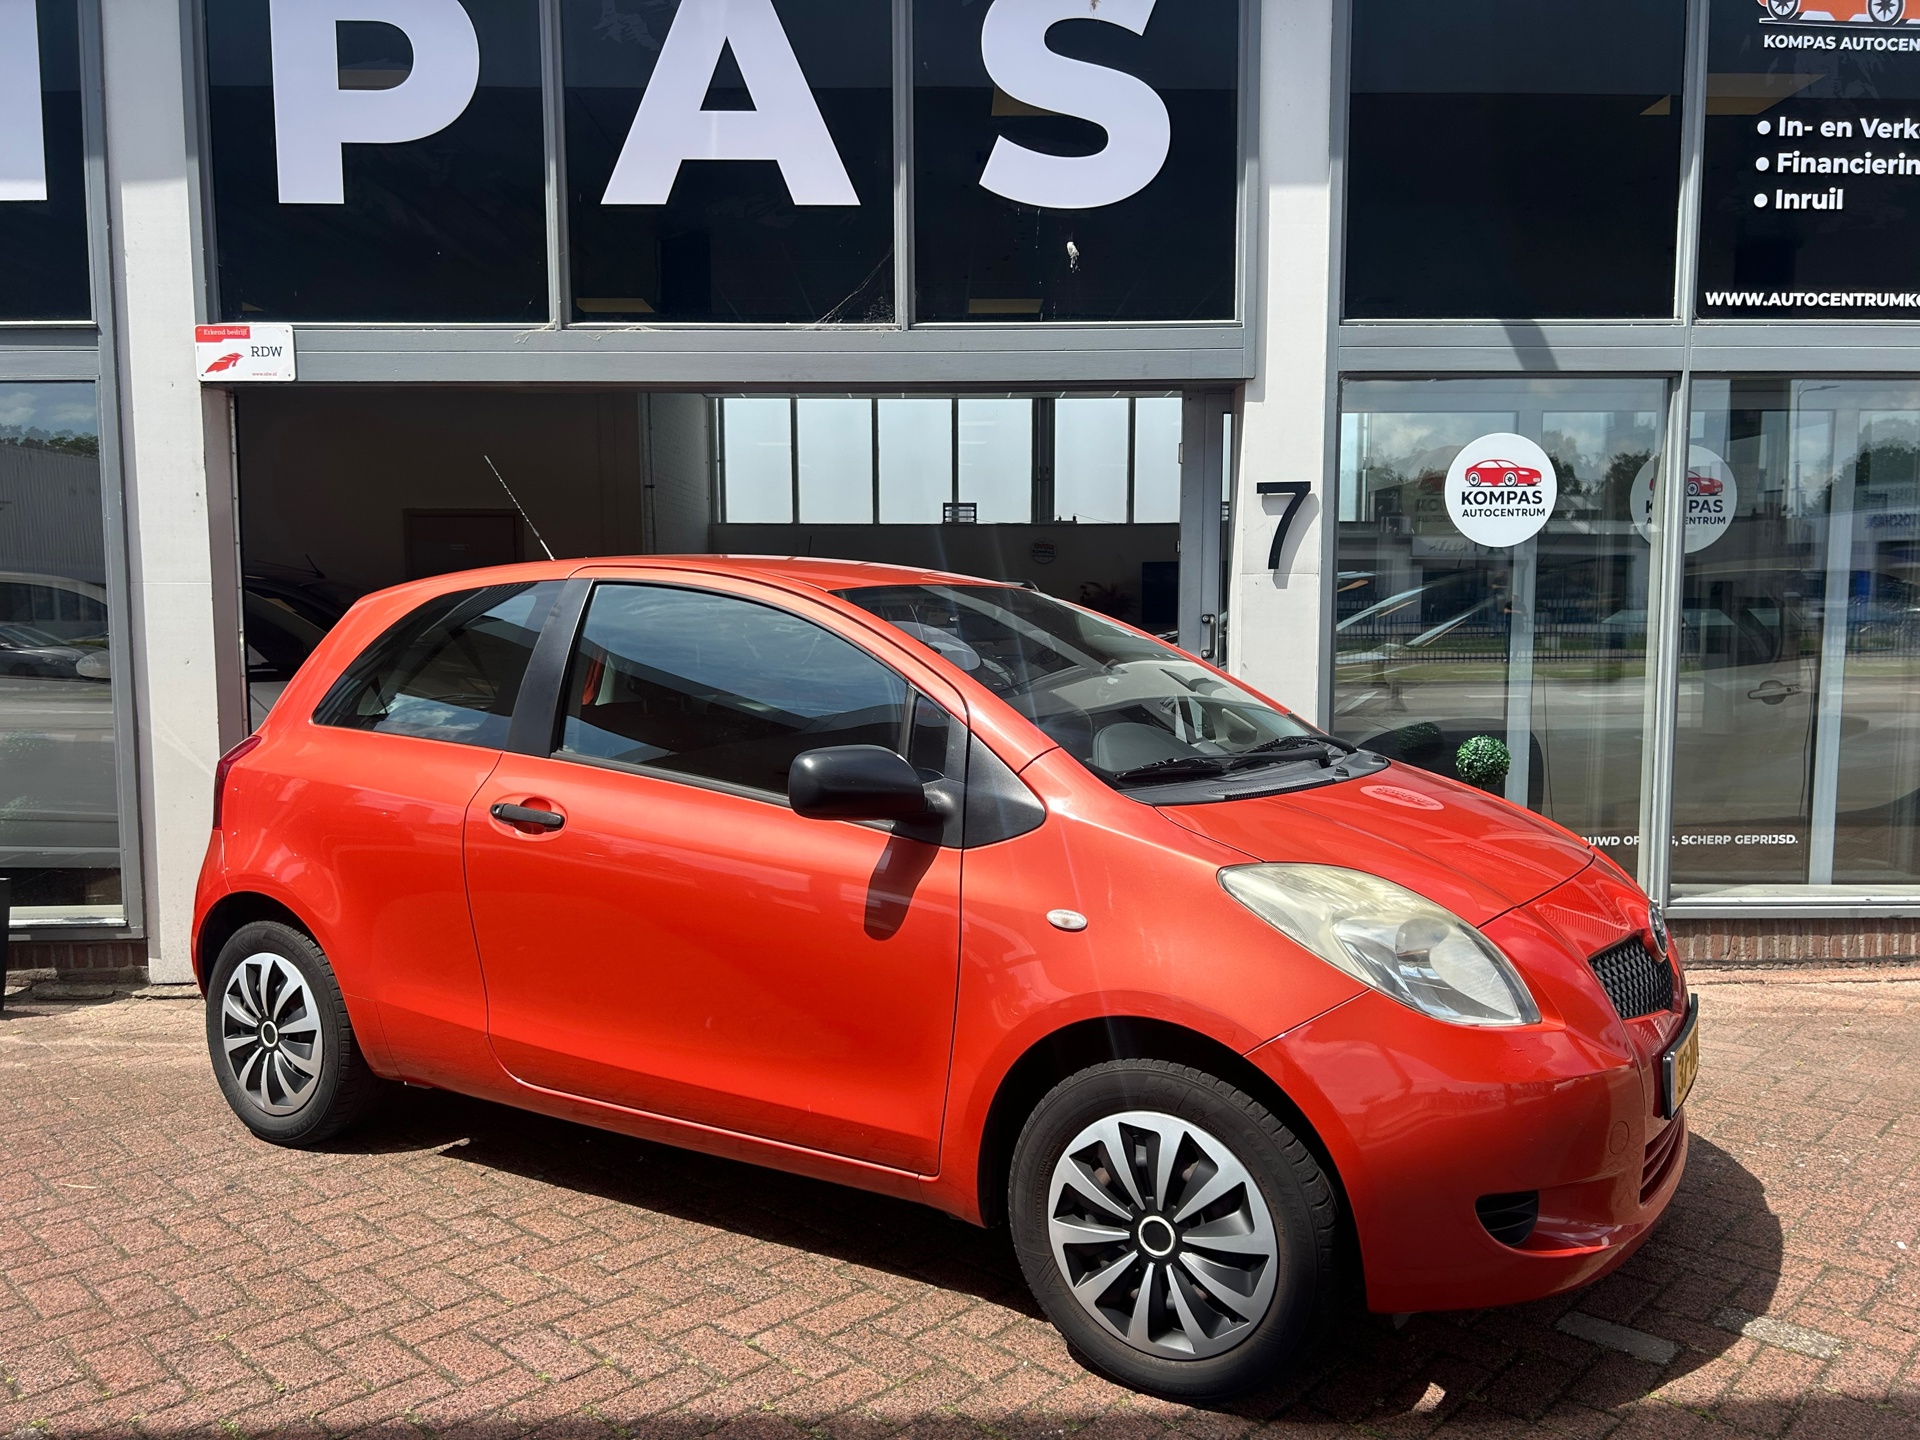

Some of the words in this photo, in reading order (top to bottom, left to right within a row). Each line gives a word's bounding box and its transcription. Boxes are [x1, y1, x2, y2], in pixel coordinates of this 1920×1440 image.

[1763, 34, 1836, 50] KOMPAS
[1840, 36, 1920, 51] AUTOCEN
[0, 0, 1171, 209] PAS
[1778, 117, 1813, 137] In-
[1820, 119, 1852, 138] en
[1860, 117, 1920, 139] Verk
[1777, 151, 1920, 175] Financierin
[1775, 187, 1844, 210] Inruil
[227, 328, 248, 337] bedrijf
[251, 346, 282, 358] RDW
[1461, 490, 1543, 505] KOMPAS
[1462, 508, 1546, 517] AUTOCENTRUM
[1645, 499, 1723, 513] KPAS
[1256, 481, 1311, 570] 7
[1646, 516, 1726, 525] ANTRUM
[1681, 835, 1732, 845] SCHERP
[1734, 834, 1799, 845] GEPRIJSD.
